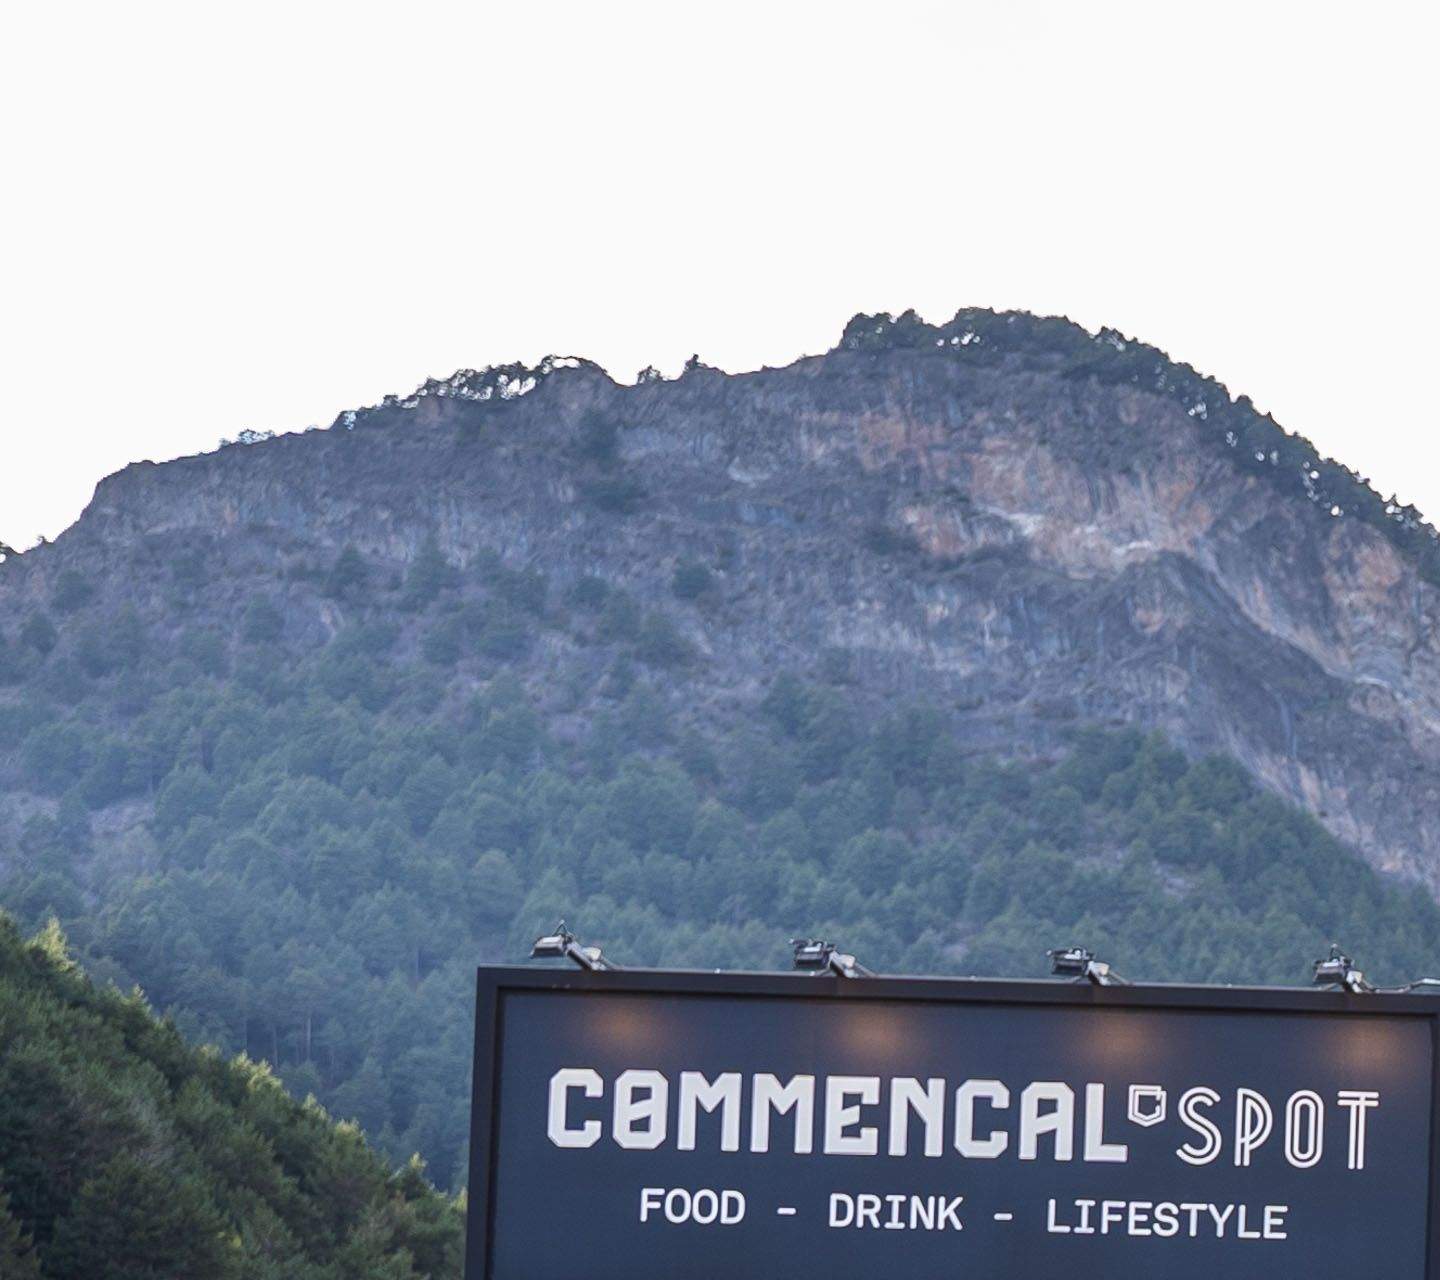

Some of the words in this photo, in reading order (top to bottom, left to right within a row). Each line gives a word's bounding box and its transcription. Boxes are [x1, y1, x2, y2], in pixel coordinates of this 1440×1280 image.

[549, 1068, 1127, 1162] COMMENCAL
[1176, 1086, 1377, 1169] SPOT
[640, 1188, 746, 1224] FOOD
[829, 1194, 963, 1231] DRINK
[1047, 1198, 1287, 1240] LIFESTYLE
